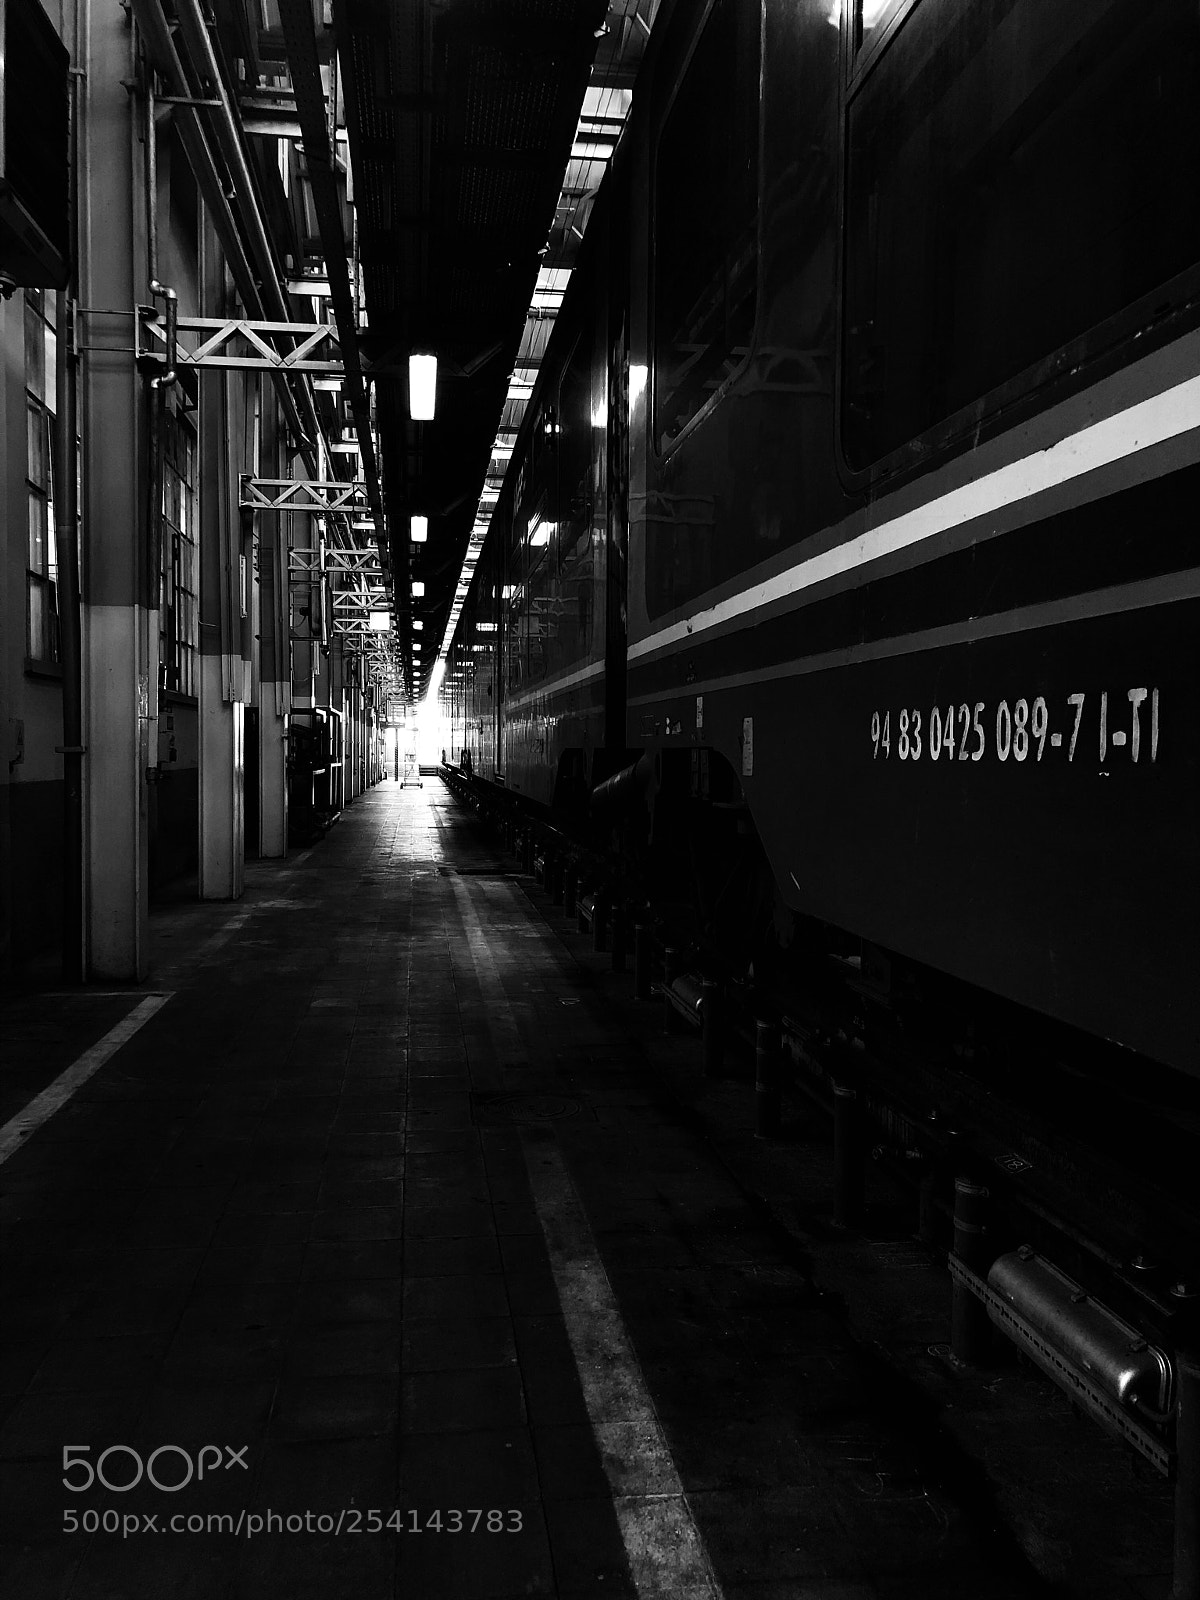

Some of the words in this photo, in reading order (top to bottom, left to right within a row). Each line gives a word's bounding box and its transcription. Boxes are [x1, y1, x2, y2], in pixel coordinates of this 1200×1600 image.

[872, 711, 890, 759] 94
[899, 709, 921, 760] 83
[930, 702, 985, 761] 0425
